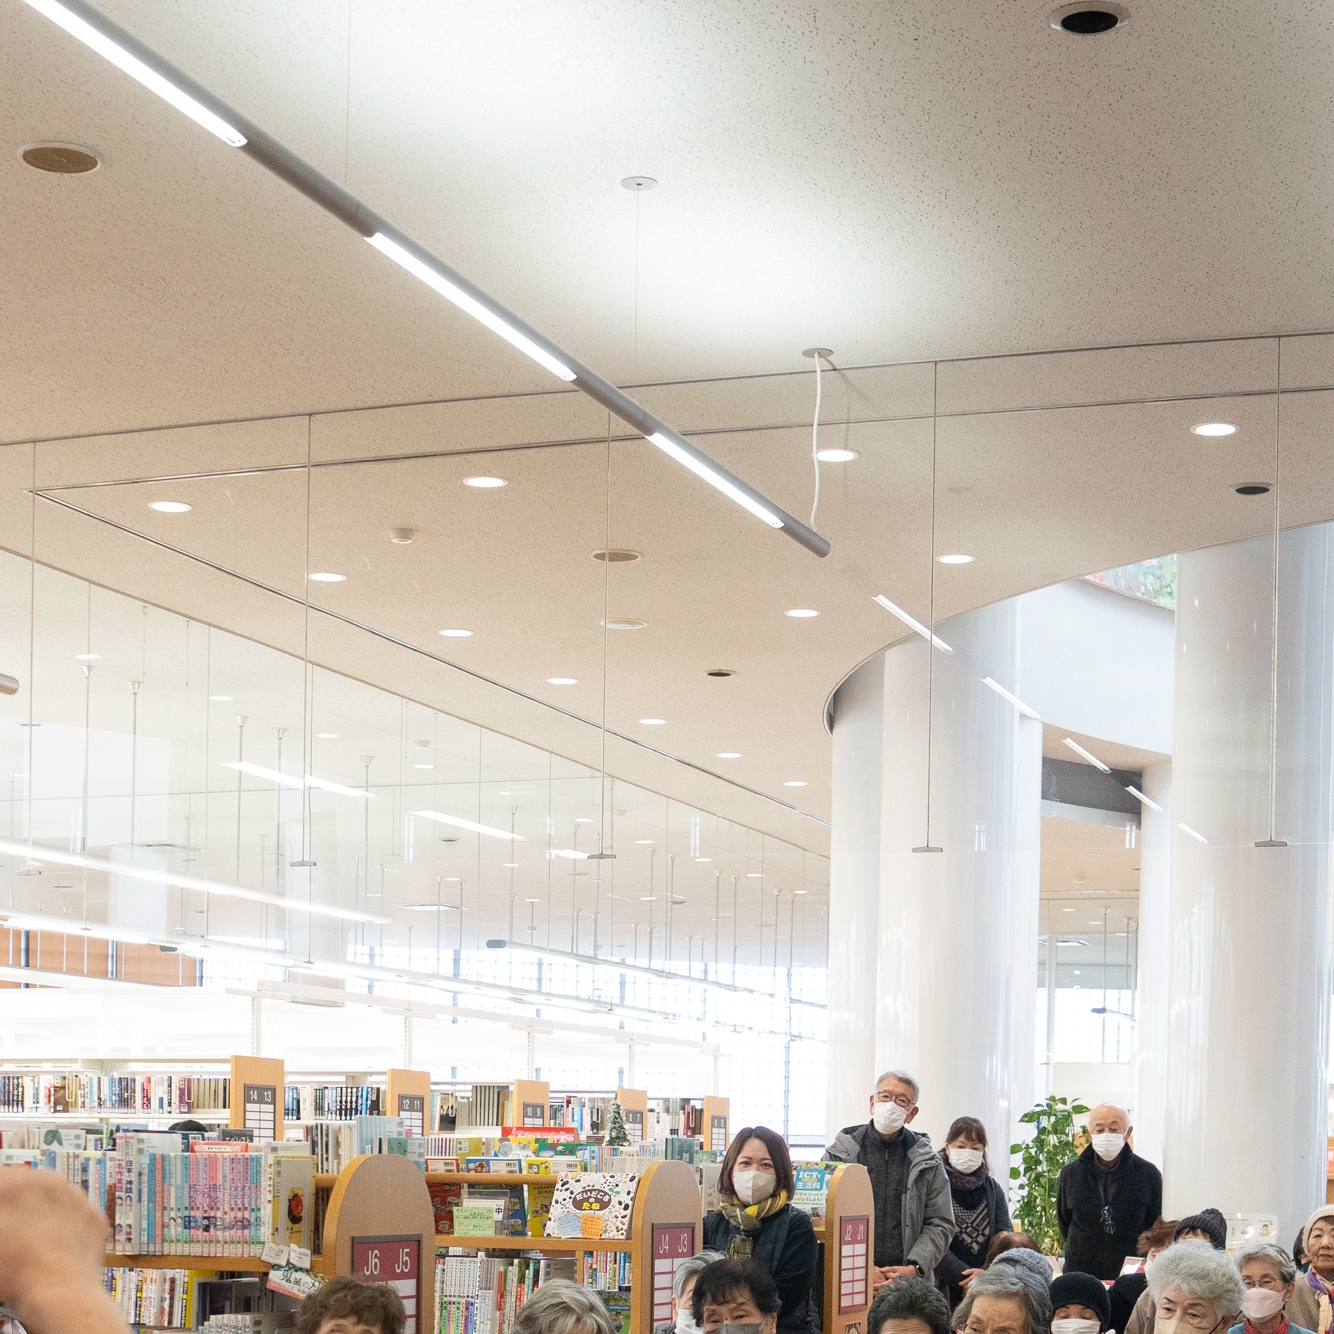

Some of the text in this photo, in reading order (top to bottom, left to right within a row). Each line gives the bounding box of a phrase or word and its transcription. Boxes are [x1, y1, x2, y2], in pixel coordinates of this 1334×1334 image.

[249, 1090, 272, 1102] 14 13
[402, 1099, 420, 1110] 12 11
[526, 1107, 541, 1117] 10 9
[796, 1181, 821, 1190] 生活科
[575, 1190, 611, 1202] だいどころ
[582, 1201, 600, 1210] たね
[845, 1224, 864, 1241] J2 J1
[659, 1233, 688, 1254] J4 J3
[364, 1248, 411, 1276] J6 J5
[279, 1269, 321, 1292] 鬼滅の刃
